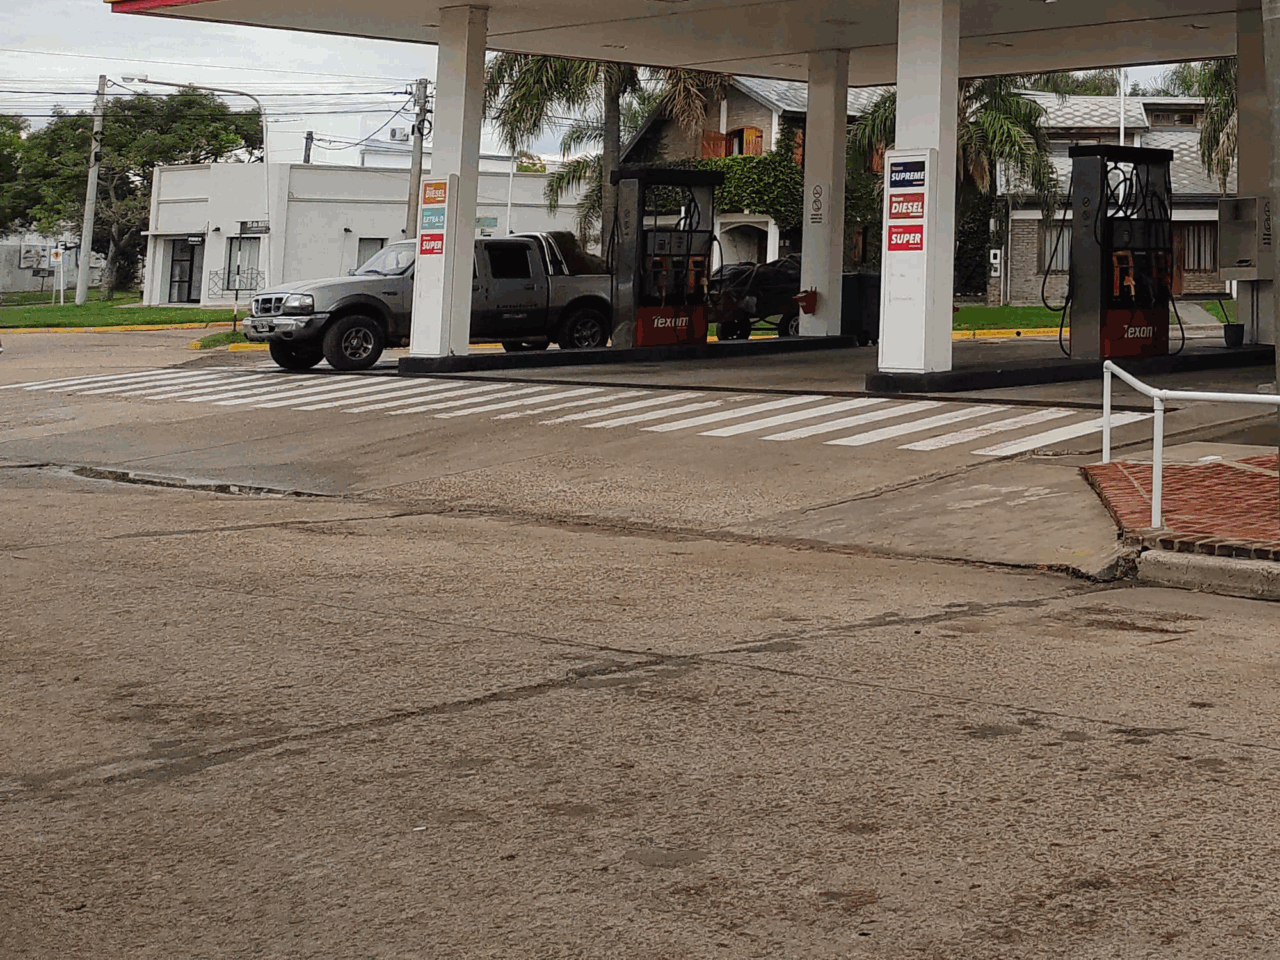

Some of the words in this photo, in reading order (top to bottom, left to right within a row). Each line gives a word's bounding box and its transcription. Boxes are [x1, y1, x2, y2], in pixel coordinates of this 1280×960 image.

[891, 171, 925, 181] SUPREME
[426, 189, 445, 198] DIESEL
[891, 201, 923, 213] DIESEL
[891, 233, 921, 244] SUPER
[422, 241, 443, 250] SUPER
